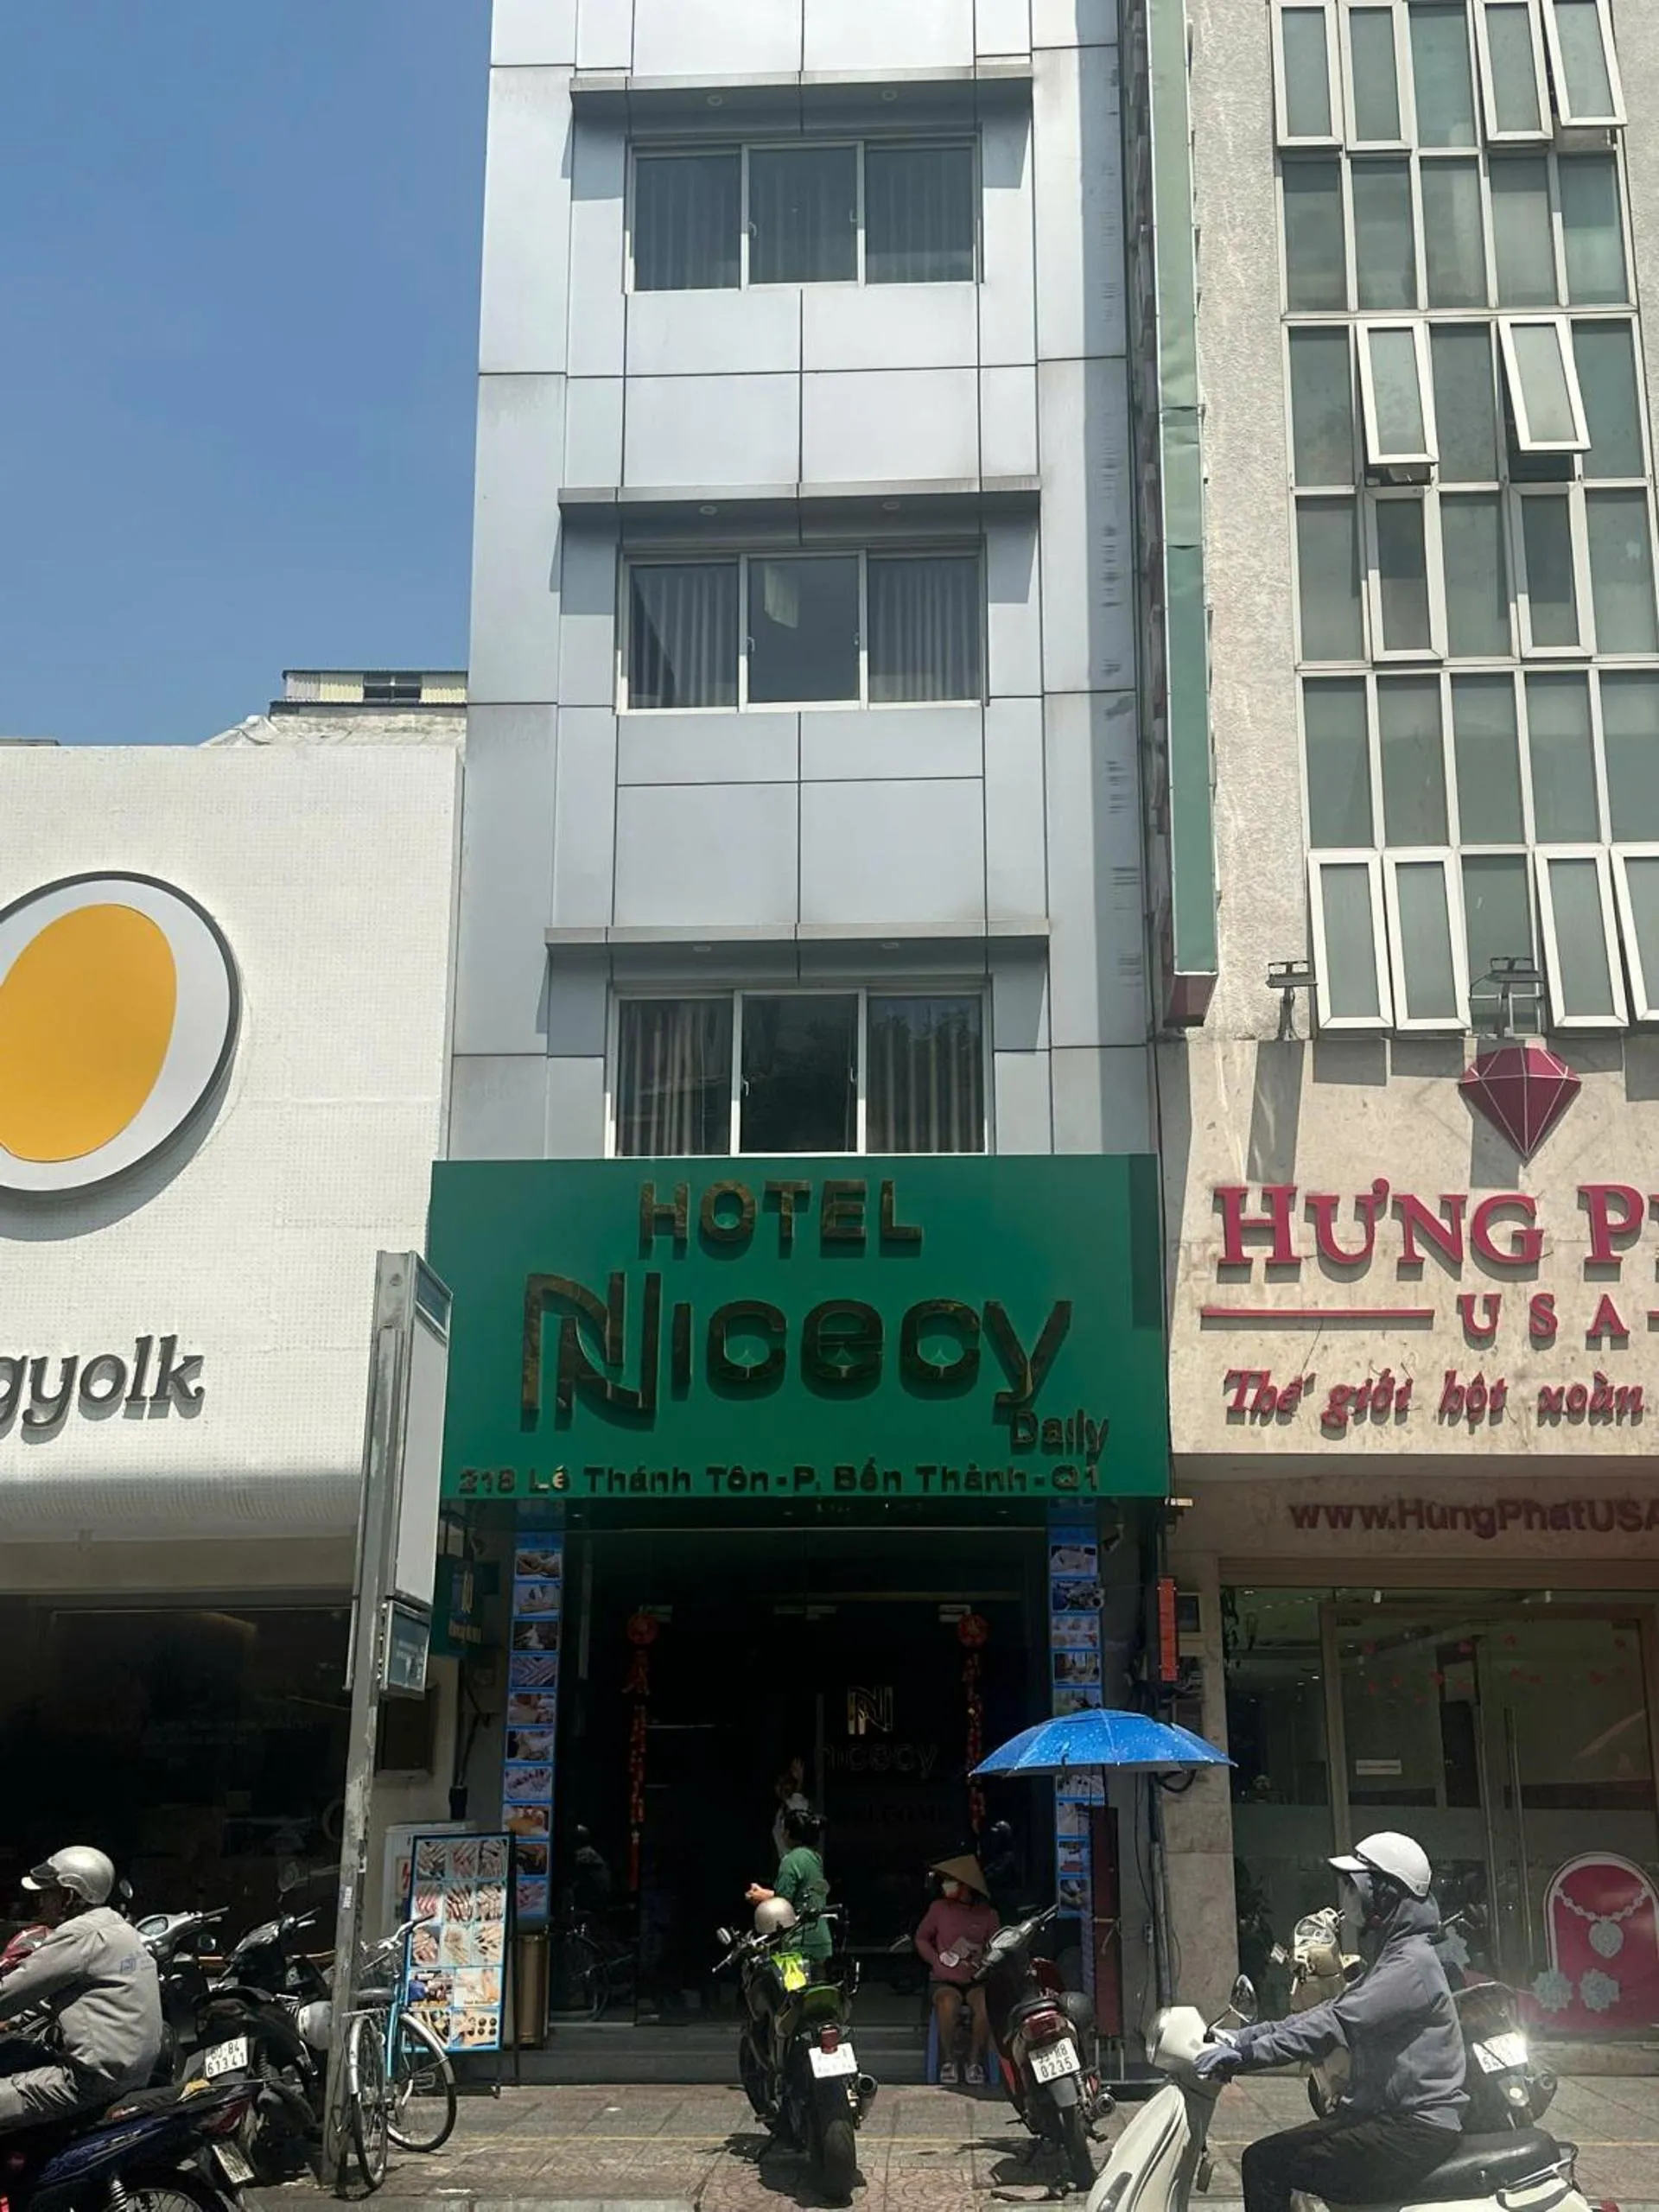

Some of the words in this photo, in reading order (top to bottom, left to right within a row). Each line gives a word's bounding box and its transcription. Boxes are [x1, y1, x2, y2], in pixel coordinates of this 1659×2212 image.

[640, 1179, 923, 1243] HOTEL
[1213, 1178, 1544, 1265] HƯNG
[1576, 1184, 1659, 1263] P
[1013, 1408, 1109, 1459] Daily
[459, 1465, 516, 1494] 218
